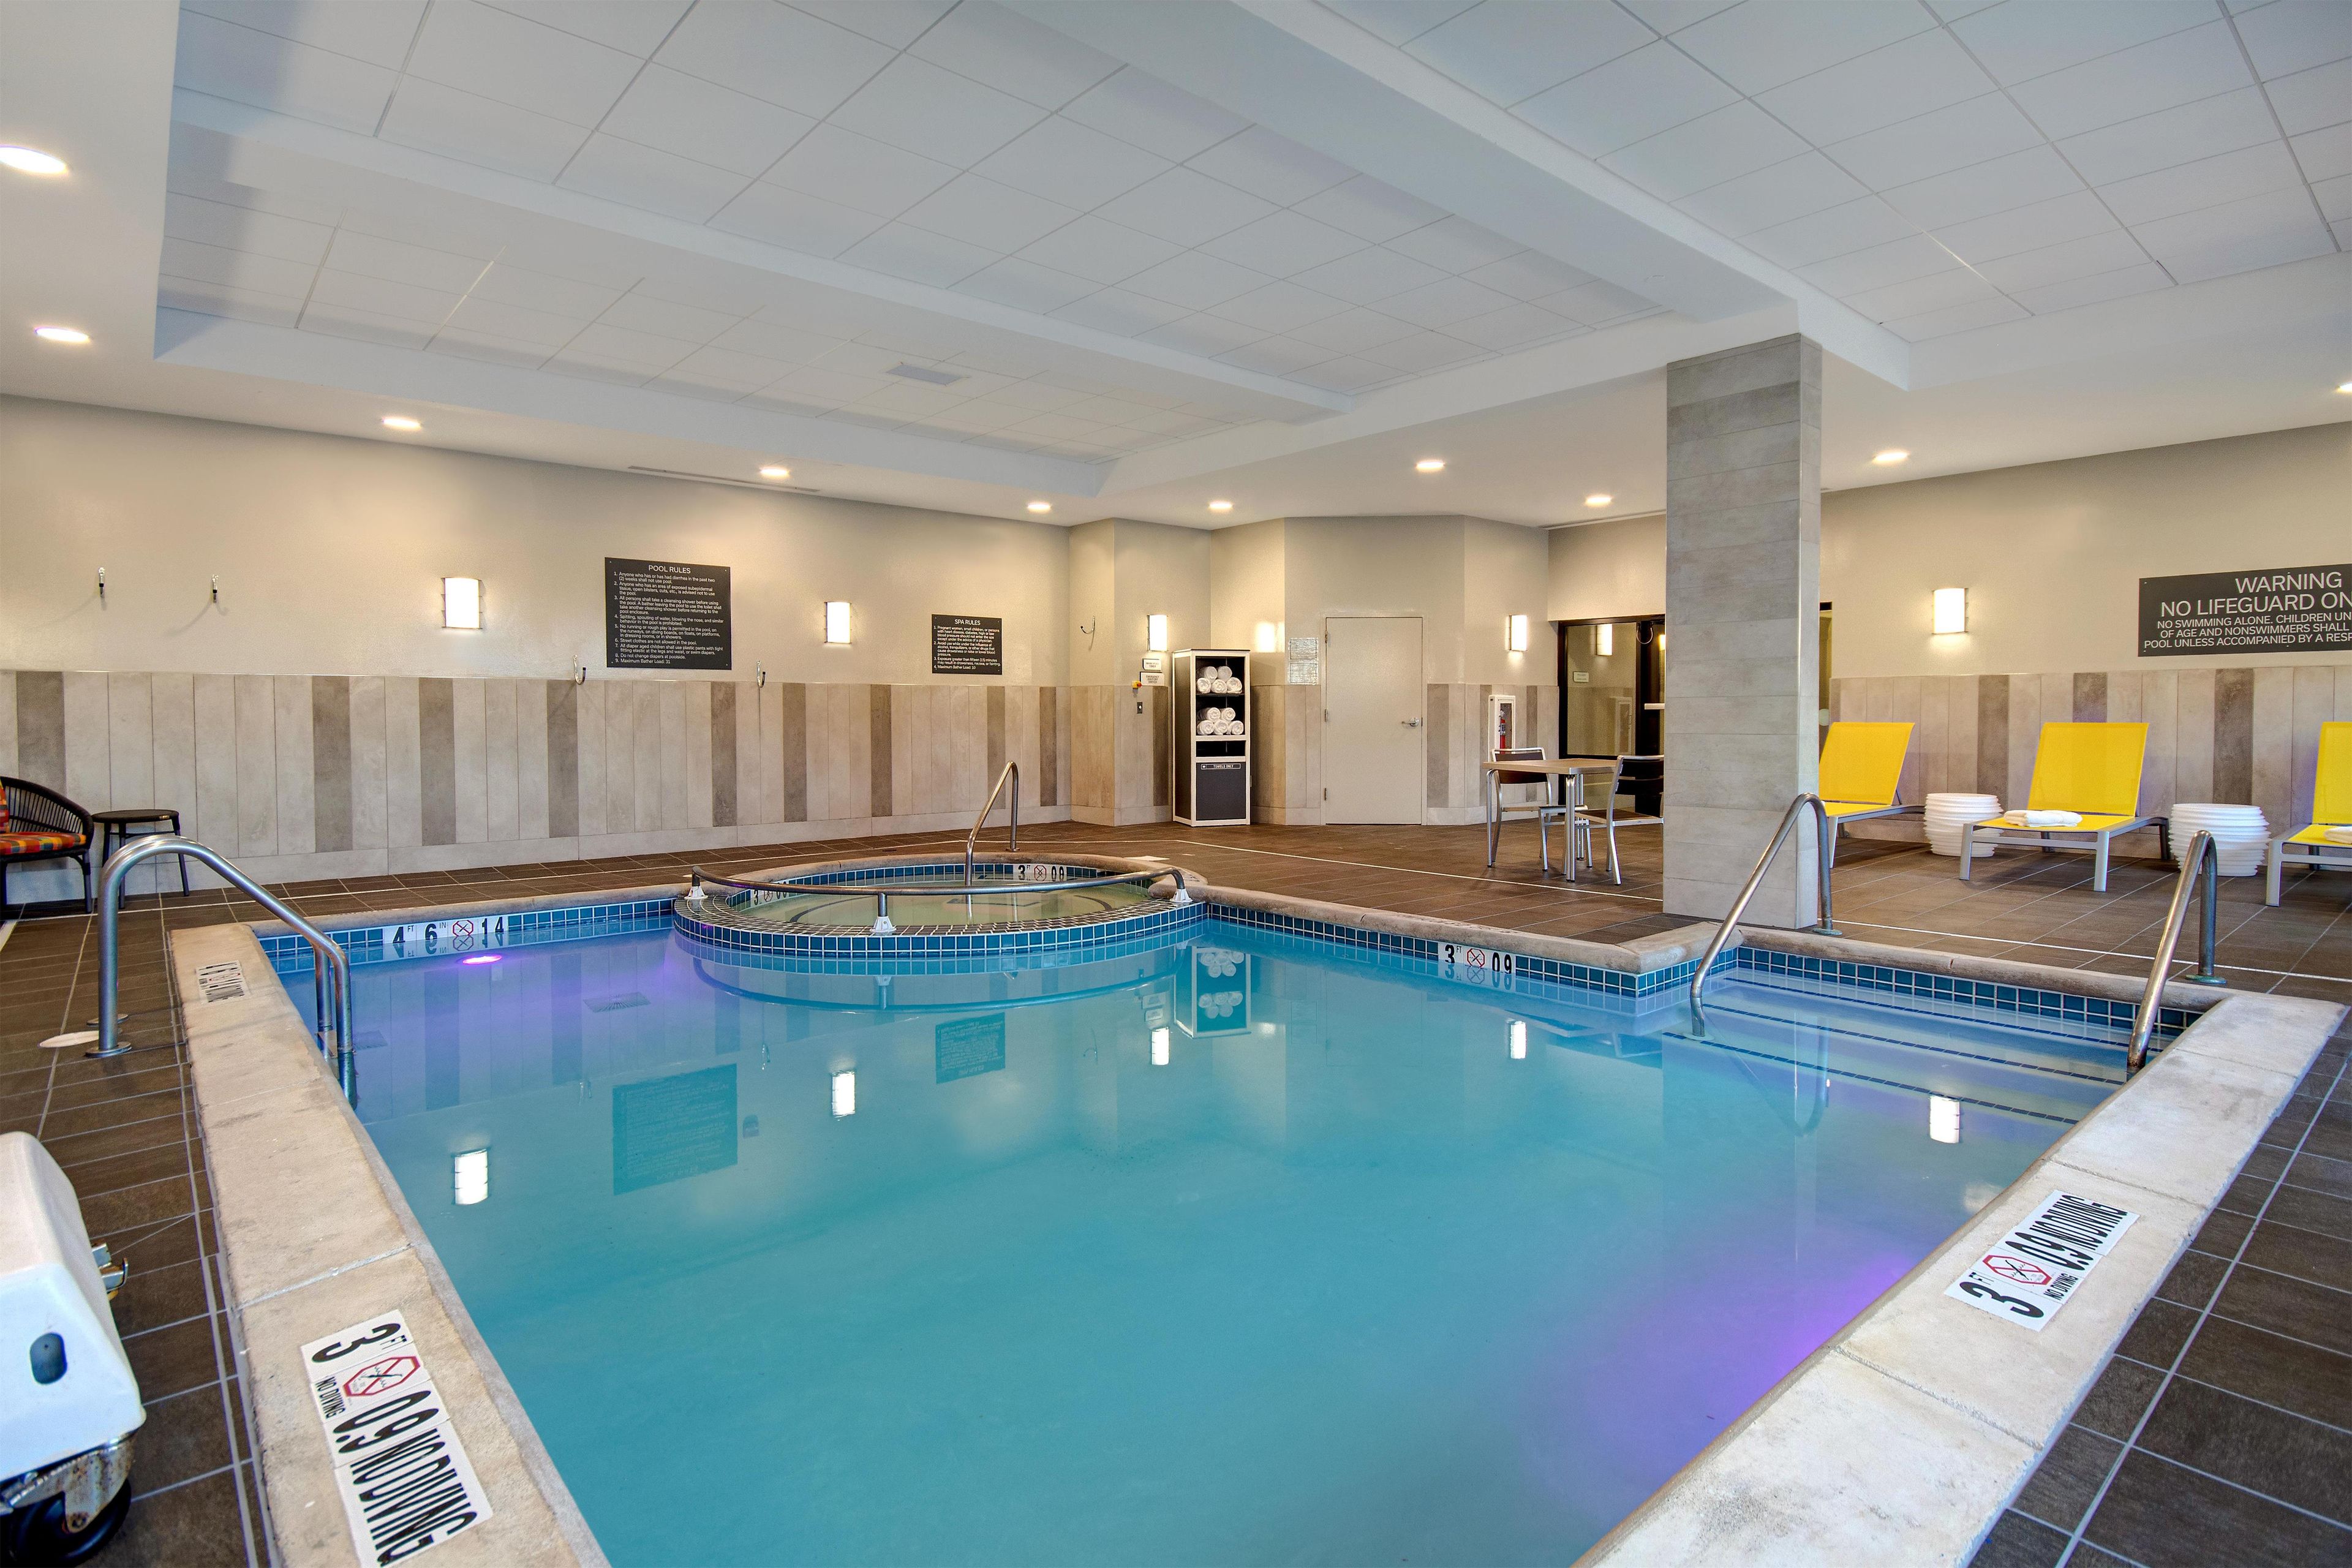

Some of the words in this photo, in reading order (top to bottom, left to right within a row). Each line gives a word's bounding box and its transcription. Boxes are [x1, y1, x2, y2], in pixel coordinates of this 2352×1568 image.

[2236, 571, 2342, 593] WARNING
[2162, 600, 2191, 617] NO
[2198, 594, 2315, 615] LIFEGUARD
[2157, 620, 2173, 628] NO
[2176, 617, 2231, 627] SWIMMING
[2234, 616, 2272, 625] ALONE.
[2276, 612, 2331, 624] CHILDREN
[2161, 630, 2174, 638] OF
[2176, 629, 2197, 638] AGE
[2199, 628, 2222, 636] AND
[2225, 624, 2310, 636] NONSWIMMERS
[2313, 622, 2350, 631] SHALL
[2144, 639, 2172, 648] POOL
[2174, 638, 2214, 647] UNLESS
[2217, 635, 2296, 646] ACCOMPANIED
[2299, 634, 2313, 643] BY
[393, 926, 405, 943] 4
[425, 924, 437, 940] 6
[1446, 944, 1455, 964] 3
[2041, 1195, 2128, 1238] DIVING
[2029, 1221, 2103, 1250] NO
[2005, 1232, 2094, 1270] 0.9
[1969, 1272, 1994, 1285] FT
[2050, 1273, 2078, 1293] DIVING
[1959, 1281, 2044, 1318] 3
[2043, 1287, 2065, 1300] NO
[312, 1323, 401, 1363] 3
[380, 1335, 407, 1350] FT
[315, 1376, 337, 1392] NO
[318, 1389, 345, 1419] DIVING
[333, 1390, 440, 1453] 0.9
[350, 1428, 446, 1485] NO
[358, 1454, 477, 1567] DIVING
